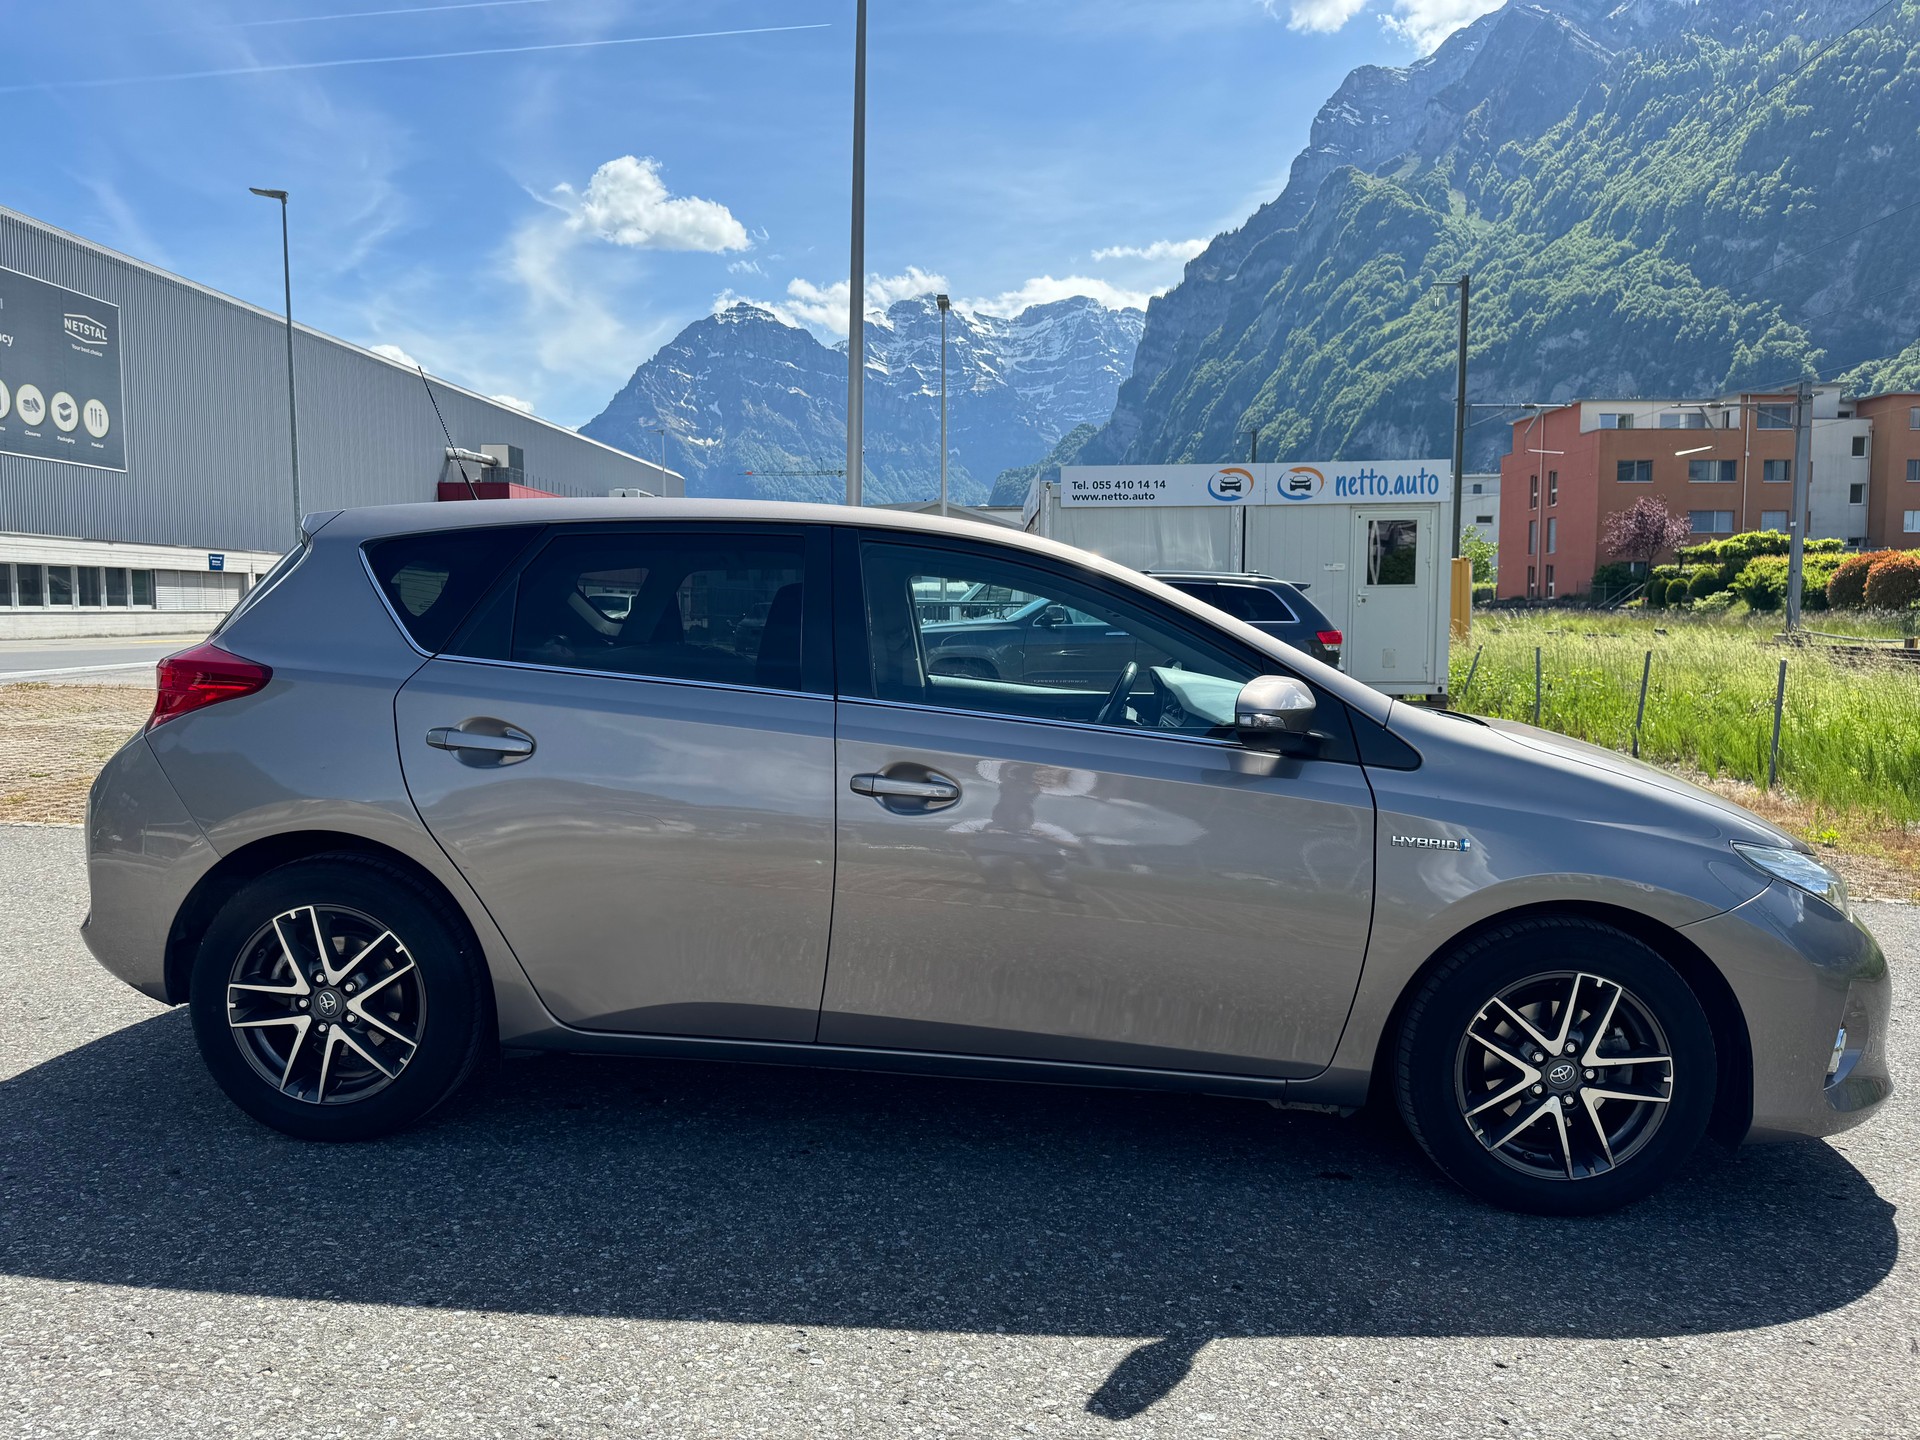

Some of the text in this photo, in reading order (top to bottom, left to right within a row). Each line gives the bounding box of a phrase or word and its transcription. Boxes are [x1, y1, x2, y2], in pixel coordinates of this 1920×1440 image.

[64, 318, 107, 340] NETSTAL
[71, 343, 81, 351] Your
[1072, 480, 1166, 490] Tel. 055 410 14 14
[1335, 467, 1439, 497] netto.auto
[1072, 492, 1155, 501] www.netto.auto
[1392, 836, 1458, 850] HYBRID
